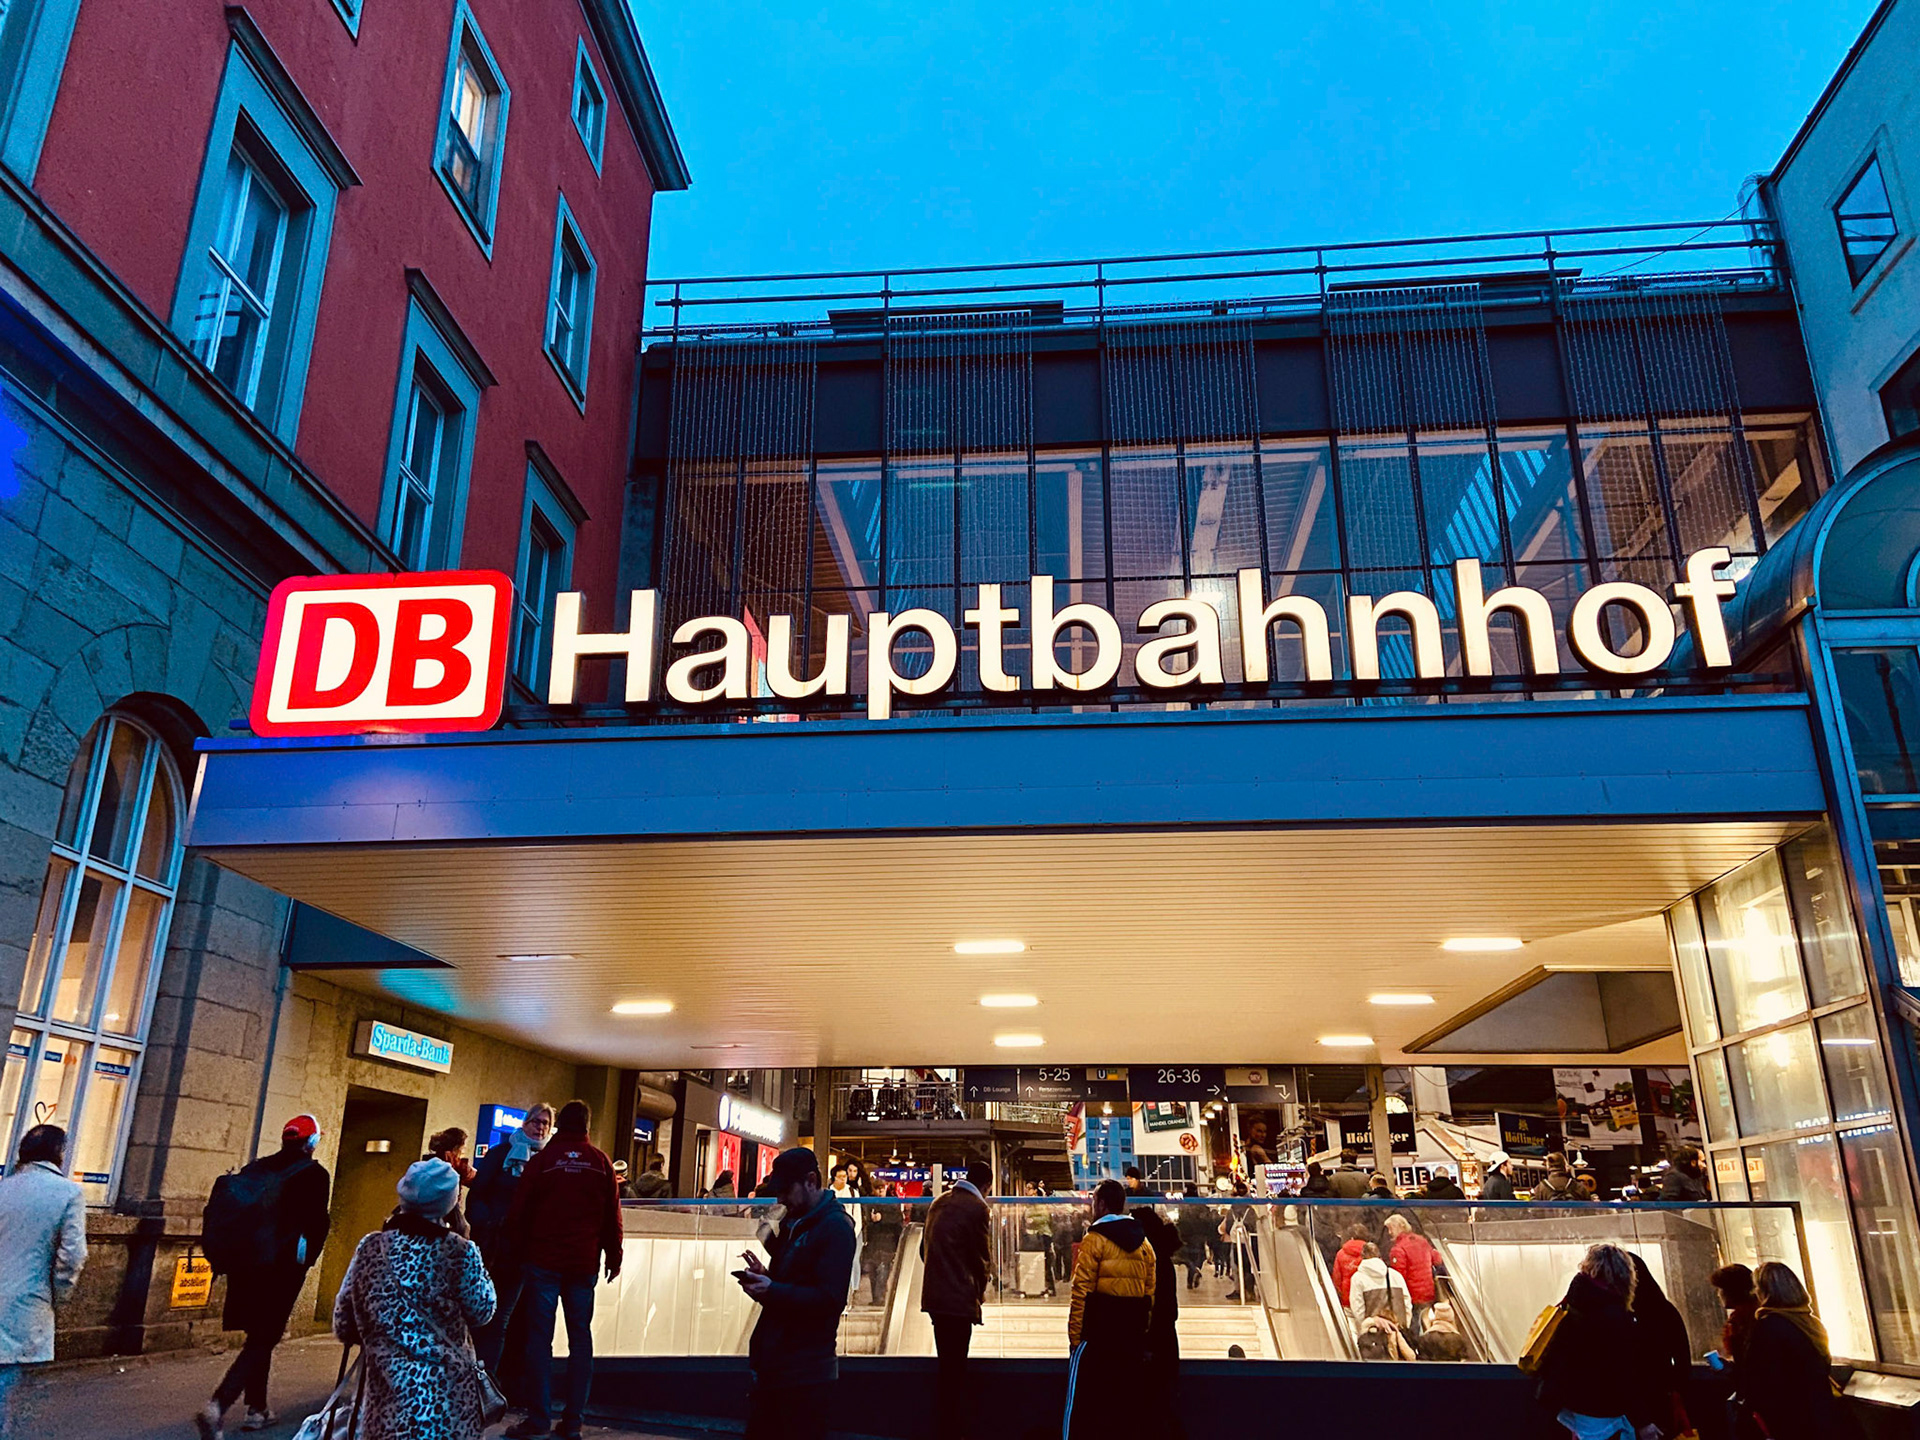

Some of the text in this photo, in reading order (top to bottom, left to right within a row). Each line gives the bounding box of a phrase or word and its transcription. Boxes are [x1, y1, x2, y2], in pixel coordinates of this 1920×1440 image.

[547, 546, 1737, 720] Hauptbahnhof
[286, 597, 474, 710] DB
[372, 1023, 450, 1066] Sparda-Bank
[1038, 1067, 1071, 1082] 5-25
[1157, 1068, 1201, 1084] 26-36
[1346, 1132, 1409, 1145] Höflger
[1504, 1131, 1545, 1147] Höflinger
